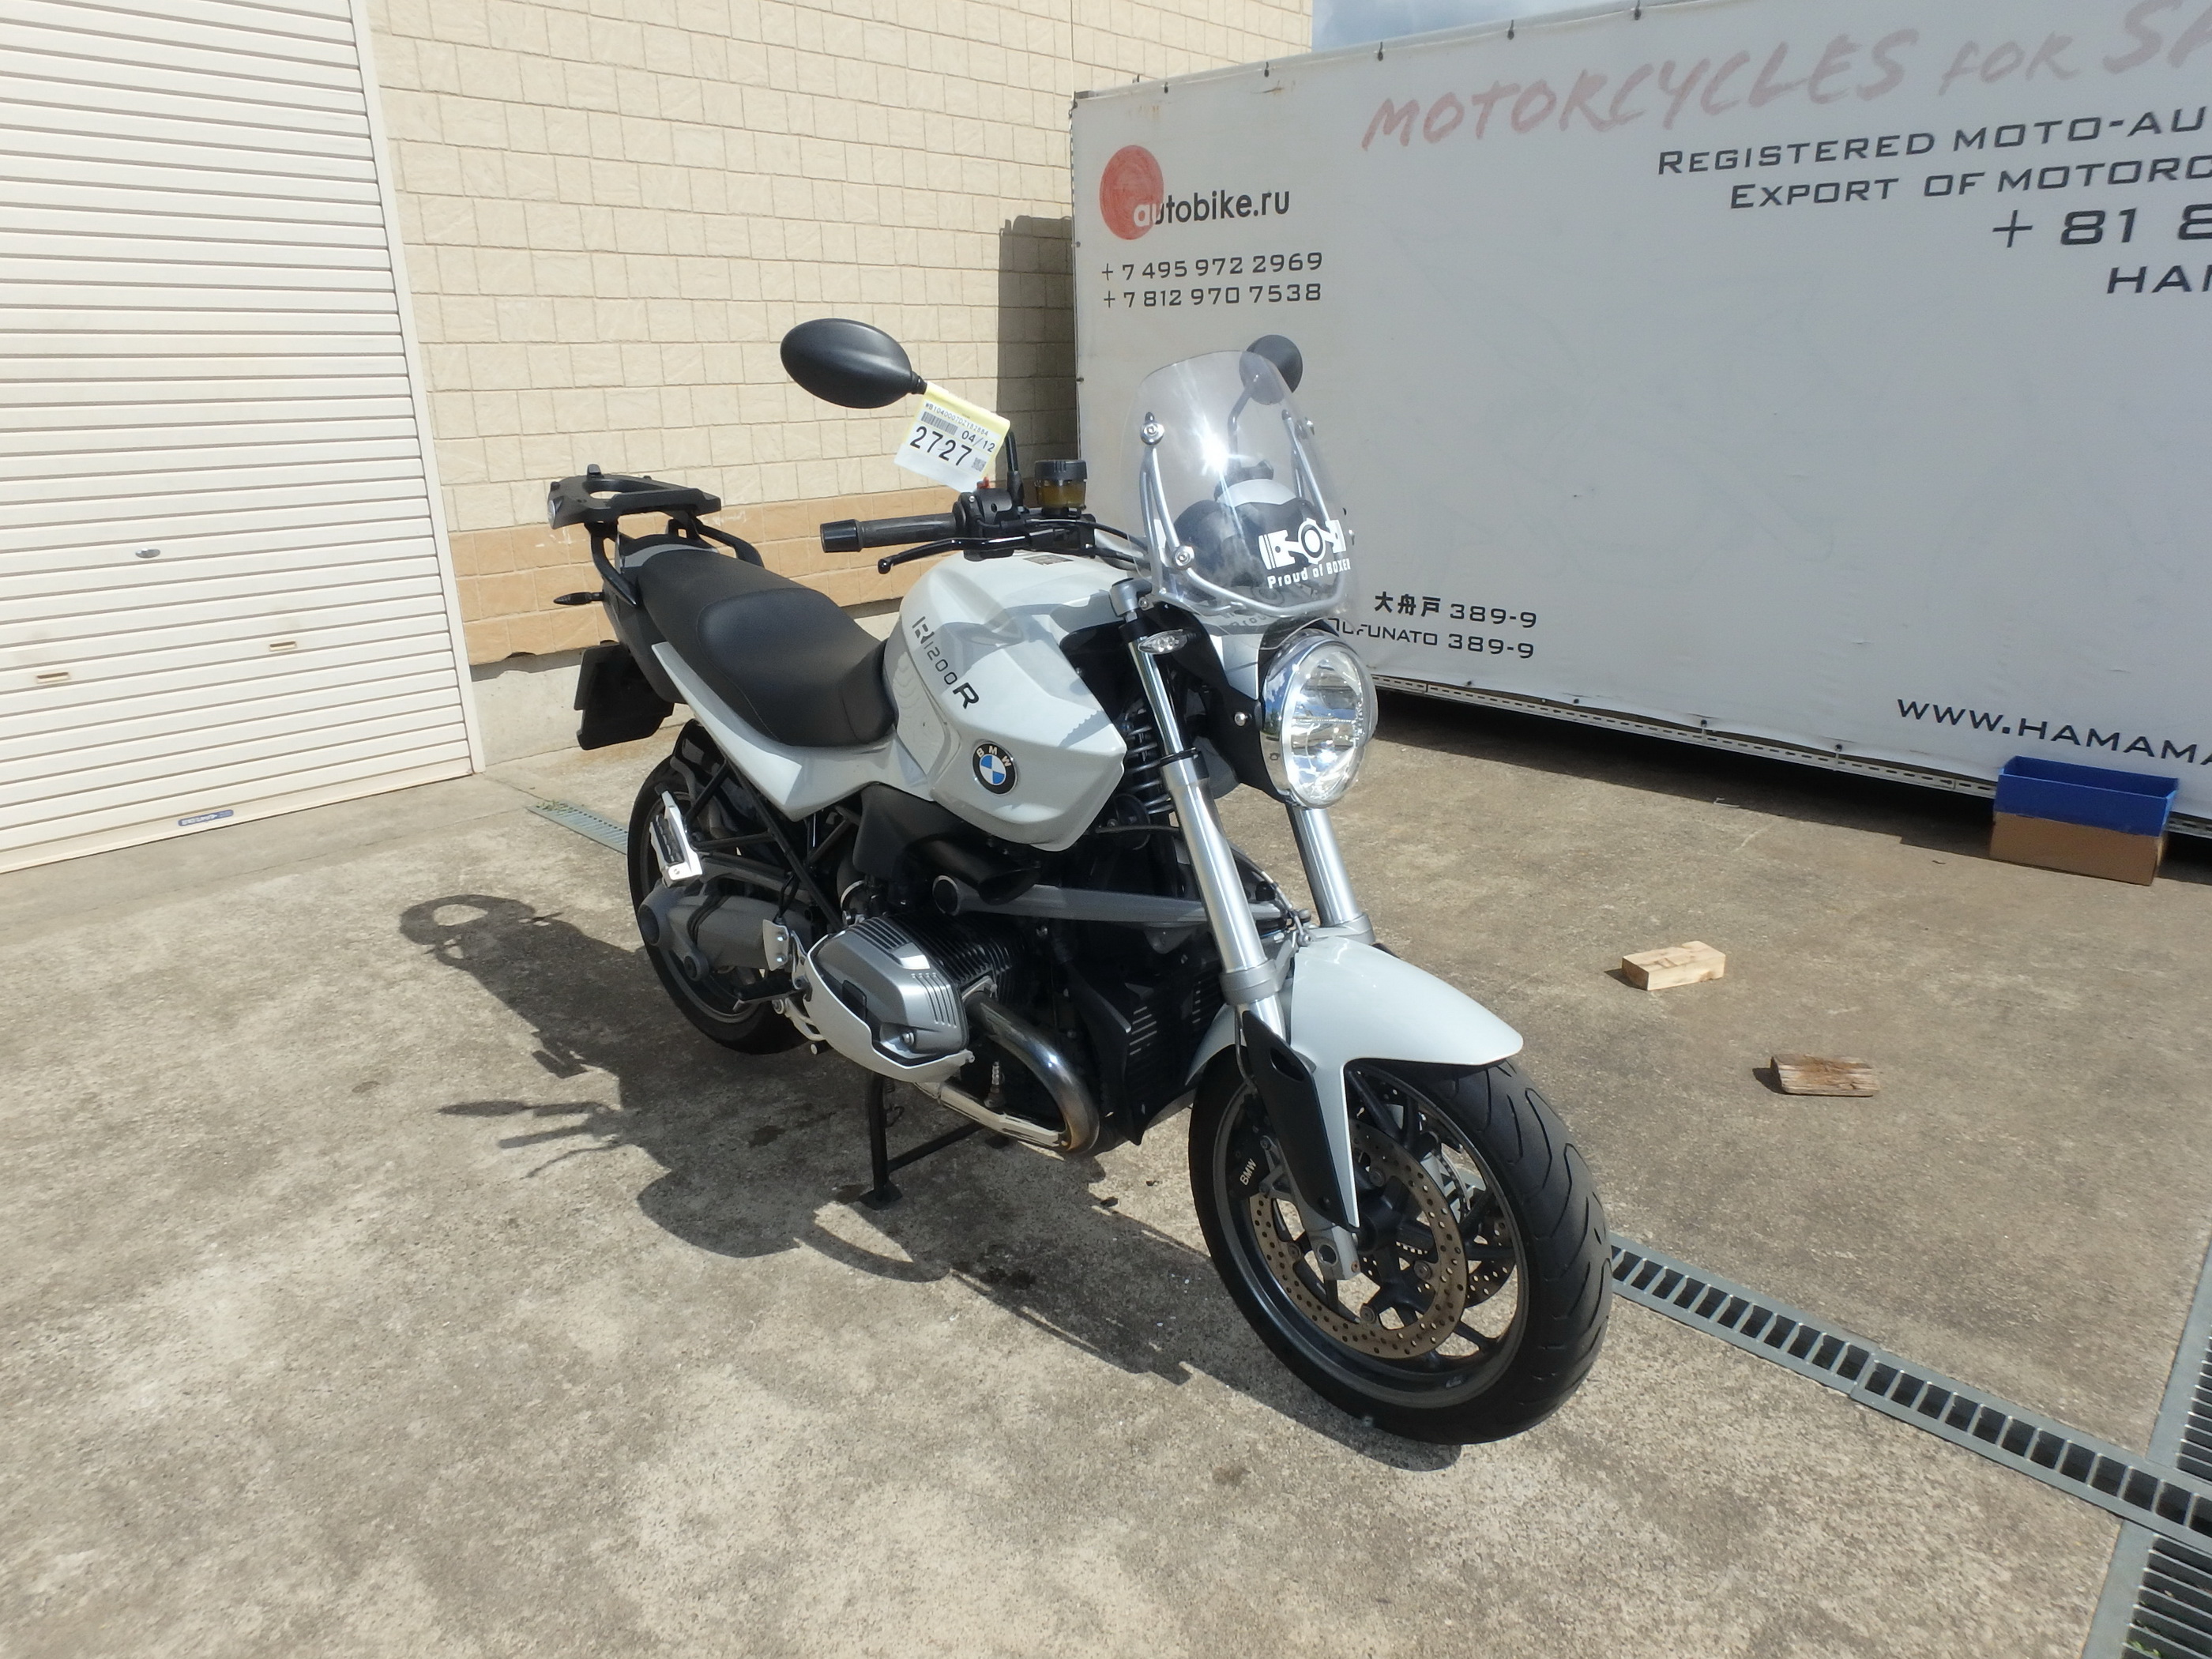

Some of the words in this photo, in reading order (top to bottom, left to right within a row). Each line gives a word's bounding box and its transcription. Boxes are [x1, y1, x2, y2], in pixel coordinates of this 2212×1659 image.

[1361, 28, 1919, 151] MOTORCYCLES
[1658, 132, 1936, 175] REGISTERED
[1730, 178, 1899, 209] EXPORT
[1923, 171, 1985, 198] OF
[1133, 190, 1290, 228] autobike.ru
[1252, 252, 1322, 273] 2969
[1249, 283, 1322, 304] 7538
[2107, 265, 2212, 294] HA
[910, 426, 972, 466] 2727
[961, 431, 995, 453] 04/12
[1266, 566, 1309, 589] Proud
[1312, 563, 1324, 578] of
[1375, 591, 1441, 617] 大舟戸
[1450, 604, 1537, 629] 389-9
[1448, 633, 1535, 659] 389-9
[976, 745, 1012, 767] BMW
[1240, 1158, 1256, 1185] BMW
